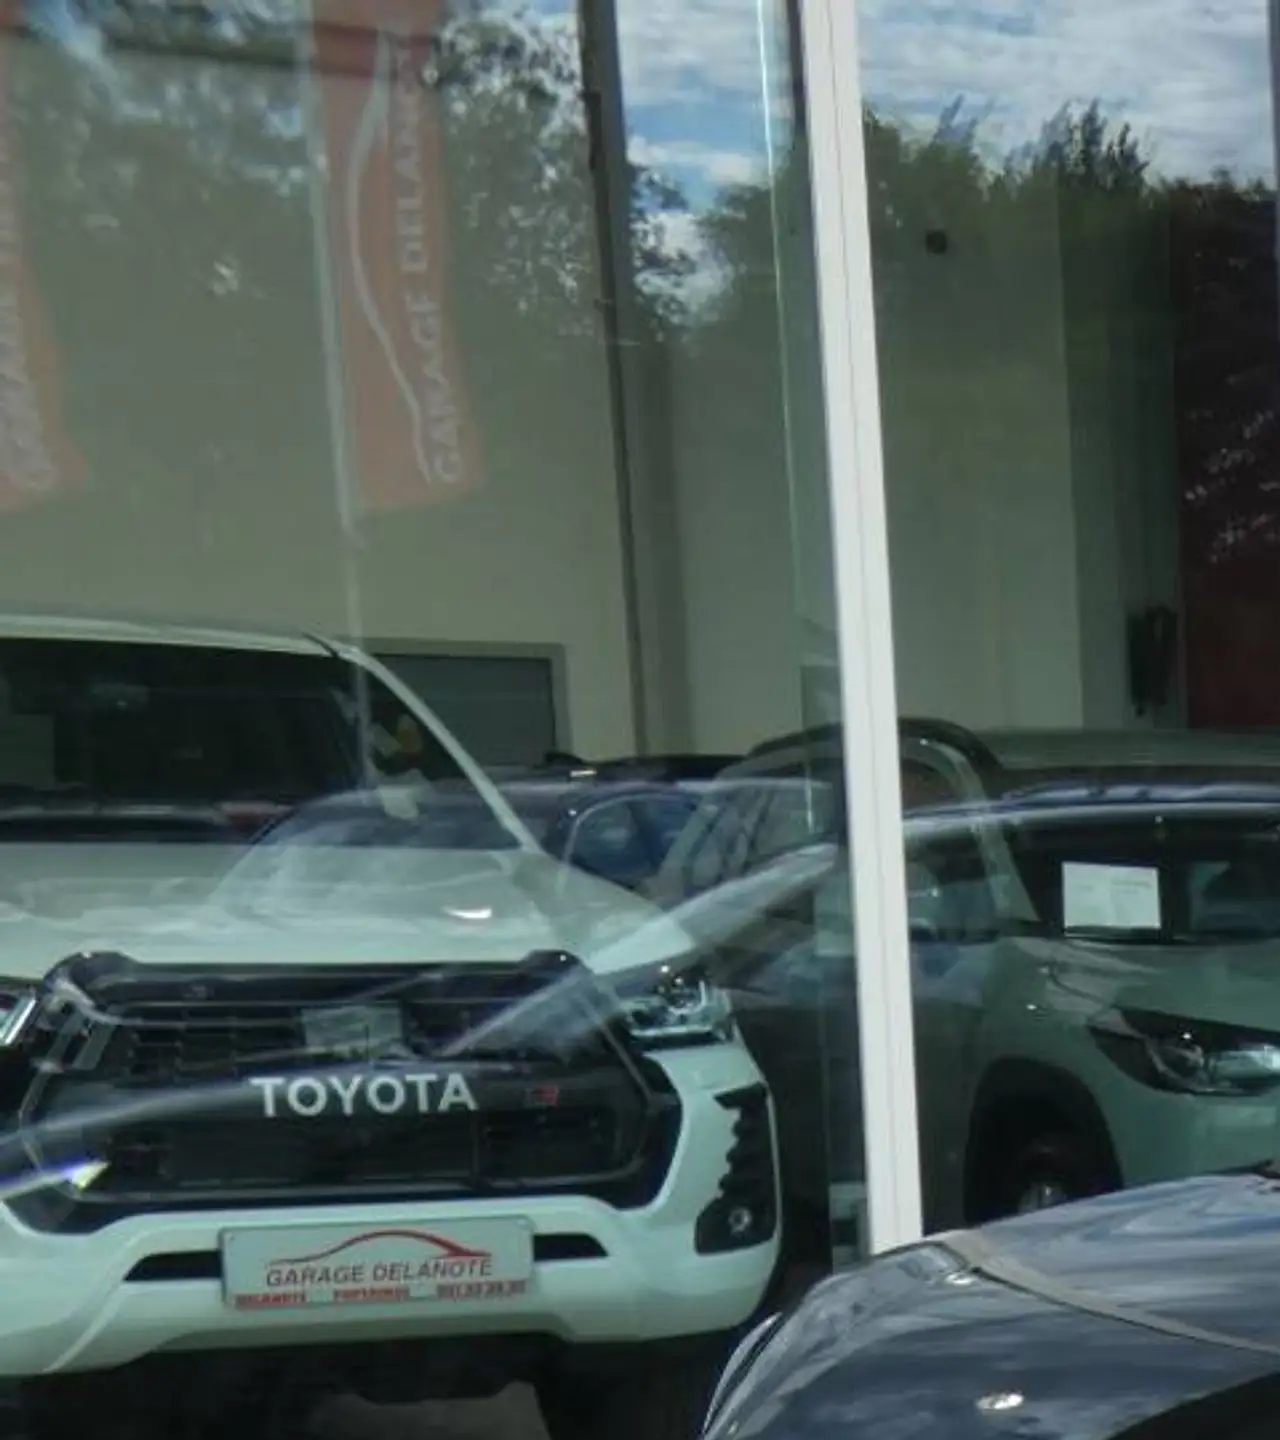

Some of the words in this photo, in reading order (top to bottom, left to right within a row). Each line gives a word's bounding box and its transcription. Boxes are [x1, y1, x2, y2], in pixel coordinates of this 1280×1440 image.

[250, 1073, 478, 1117] TOYOTA
[266, 1264, 365, 1287] GARAGE
[372, 1258, 494, 1282] DELANOTE
